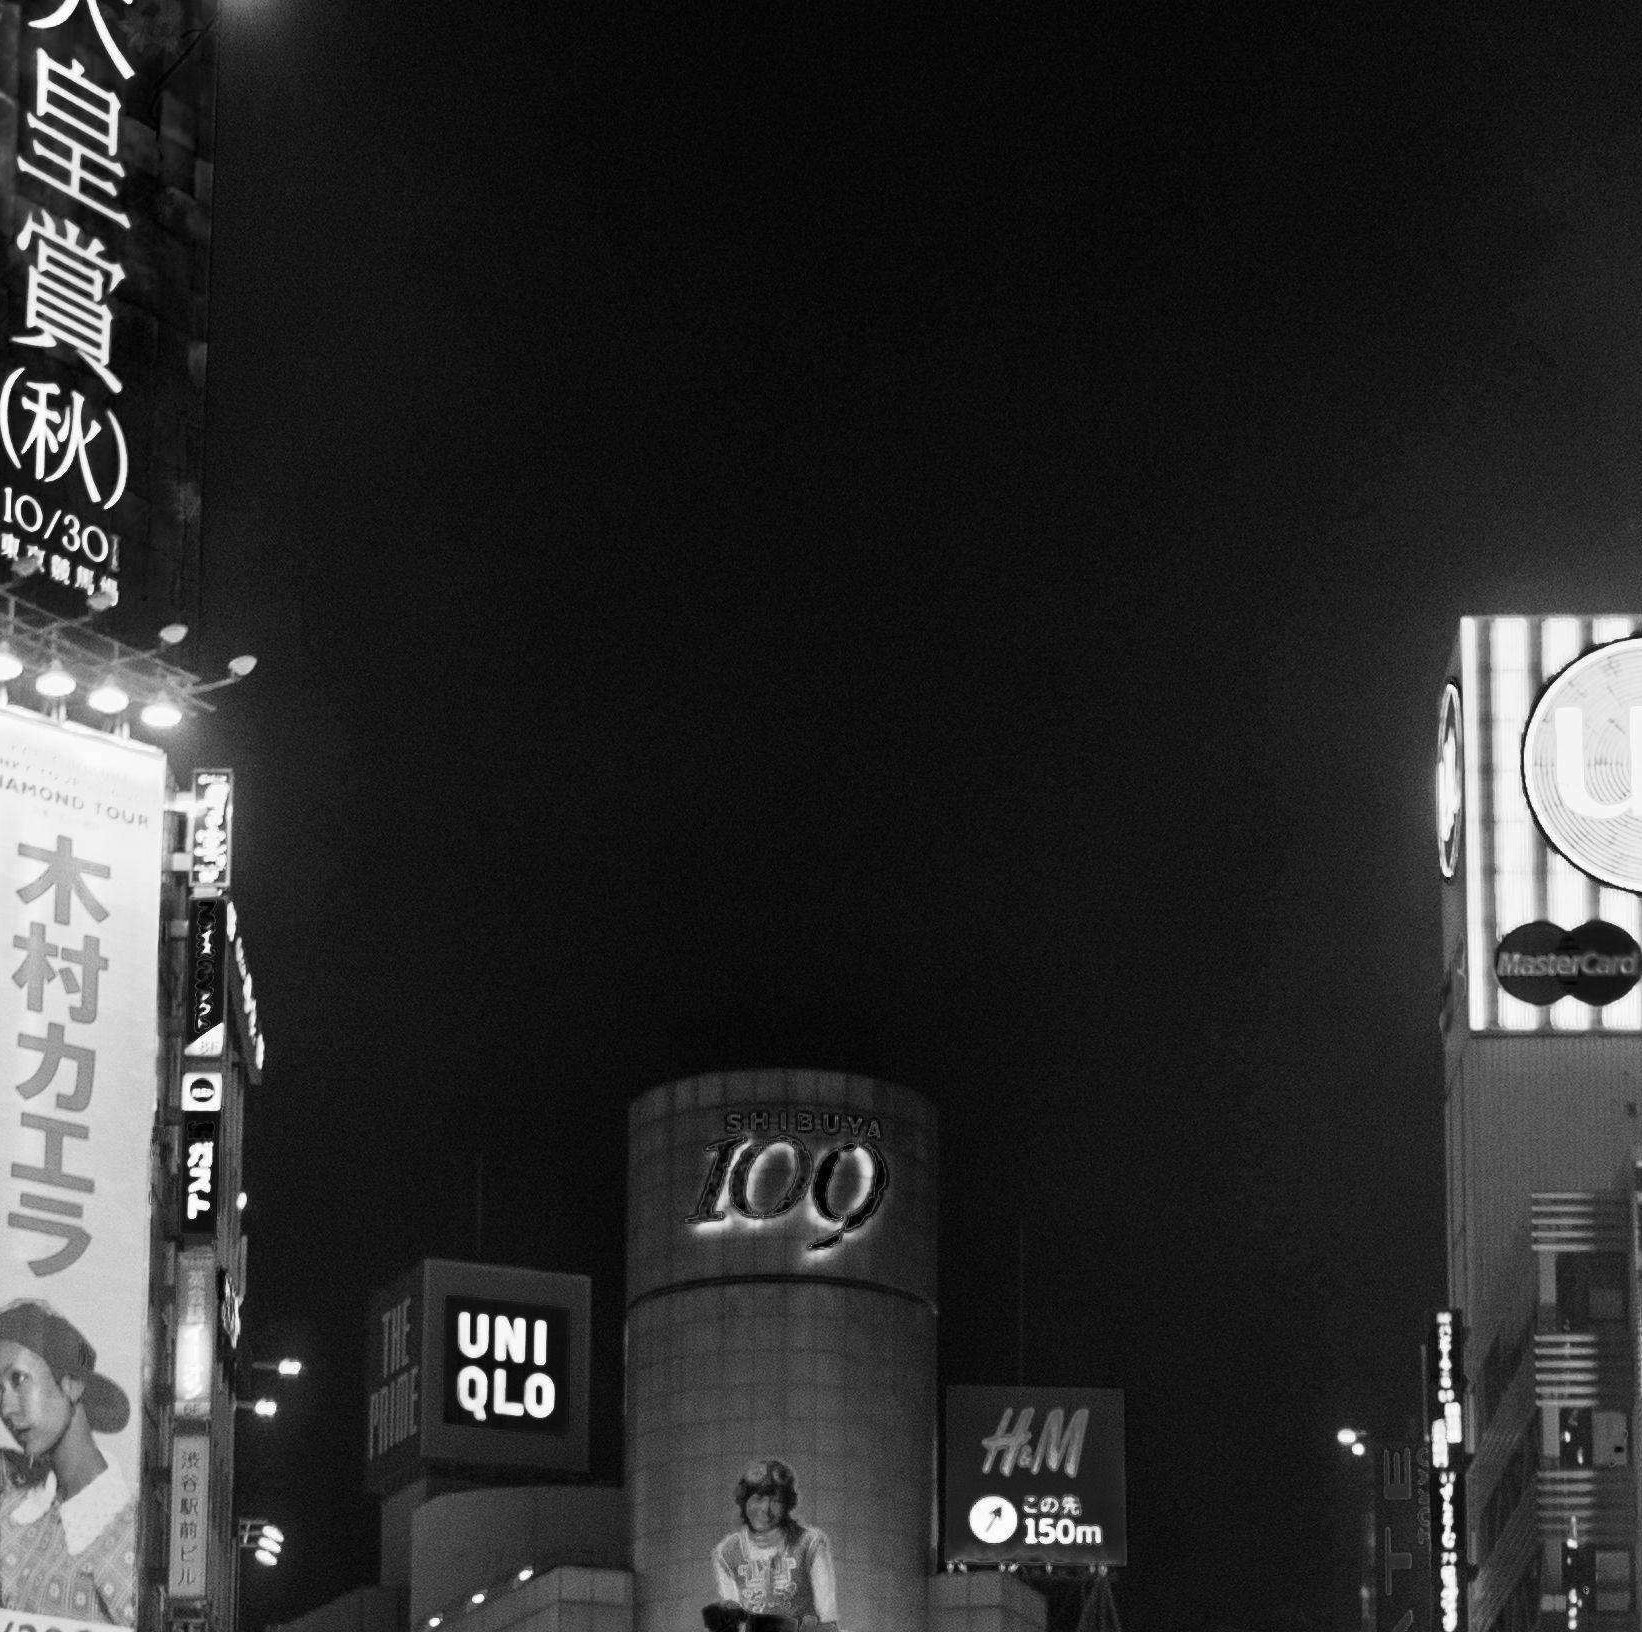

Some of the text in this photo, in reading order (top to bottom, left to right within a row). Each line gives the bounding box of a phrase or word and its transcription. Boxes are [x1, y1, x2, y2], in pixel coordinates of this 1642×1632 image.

[94, 802, 150, 829] TOUR
[1496, 951, 1640, 977] MasterCard
[7, 834, 112, 1278] 木村カエラ
[724, 1109, 884, 1139] SHIBUYA
[684, 1132, 891, 1252] 109
[457, 1310, 548, 1366] UNI
[456, 1364, 556, 1422] QLO
[981, 1405, 1090, 1479] H&M
[179, 1450, 202, 1586] 渋谷駅前ビル
[1022, 1494, 1082, 1517] この先
[1023, 1517, 1103, 1549] 150m
